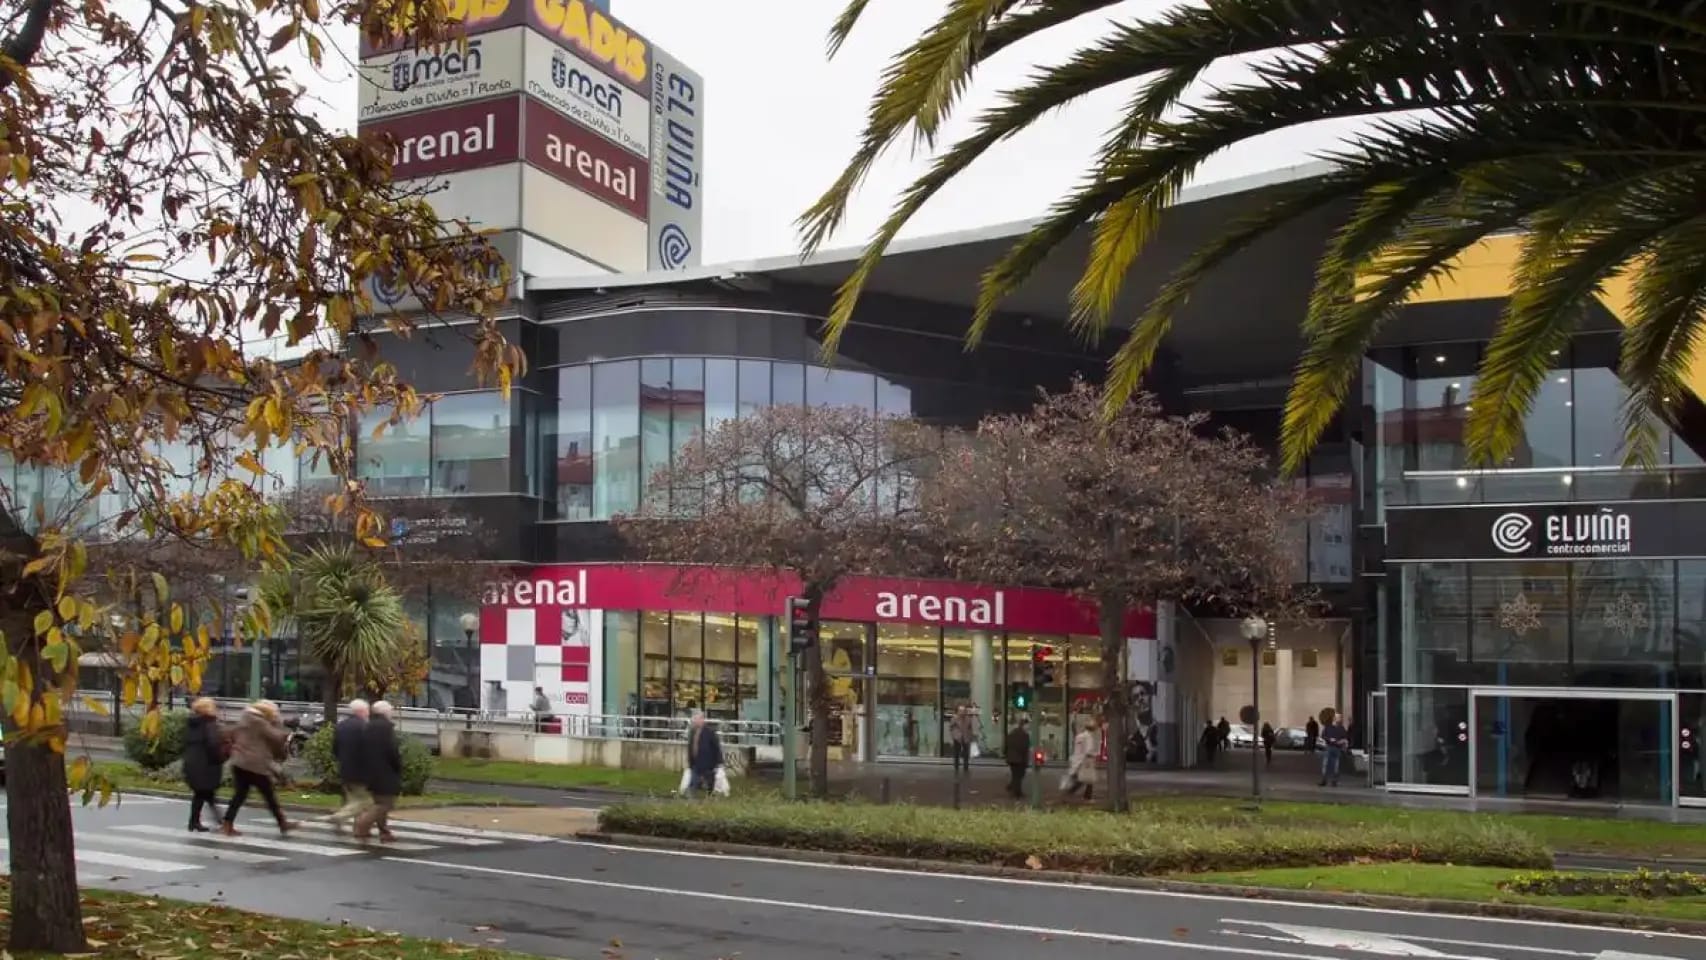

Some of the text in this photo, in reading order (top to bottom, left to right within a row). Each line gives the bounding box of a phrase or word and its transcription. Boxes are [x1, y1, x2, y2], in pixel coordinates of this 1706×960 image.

[546, 133, 636, 200] arenal
[1547, 508, 1630, 541] ELVIÑA
[875, 591, 1004, 625] arenal
